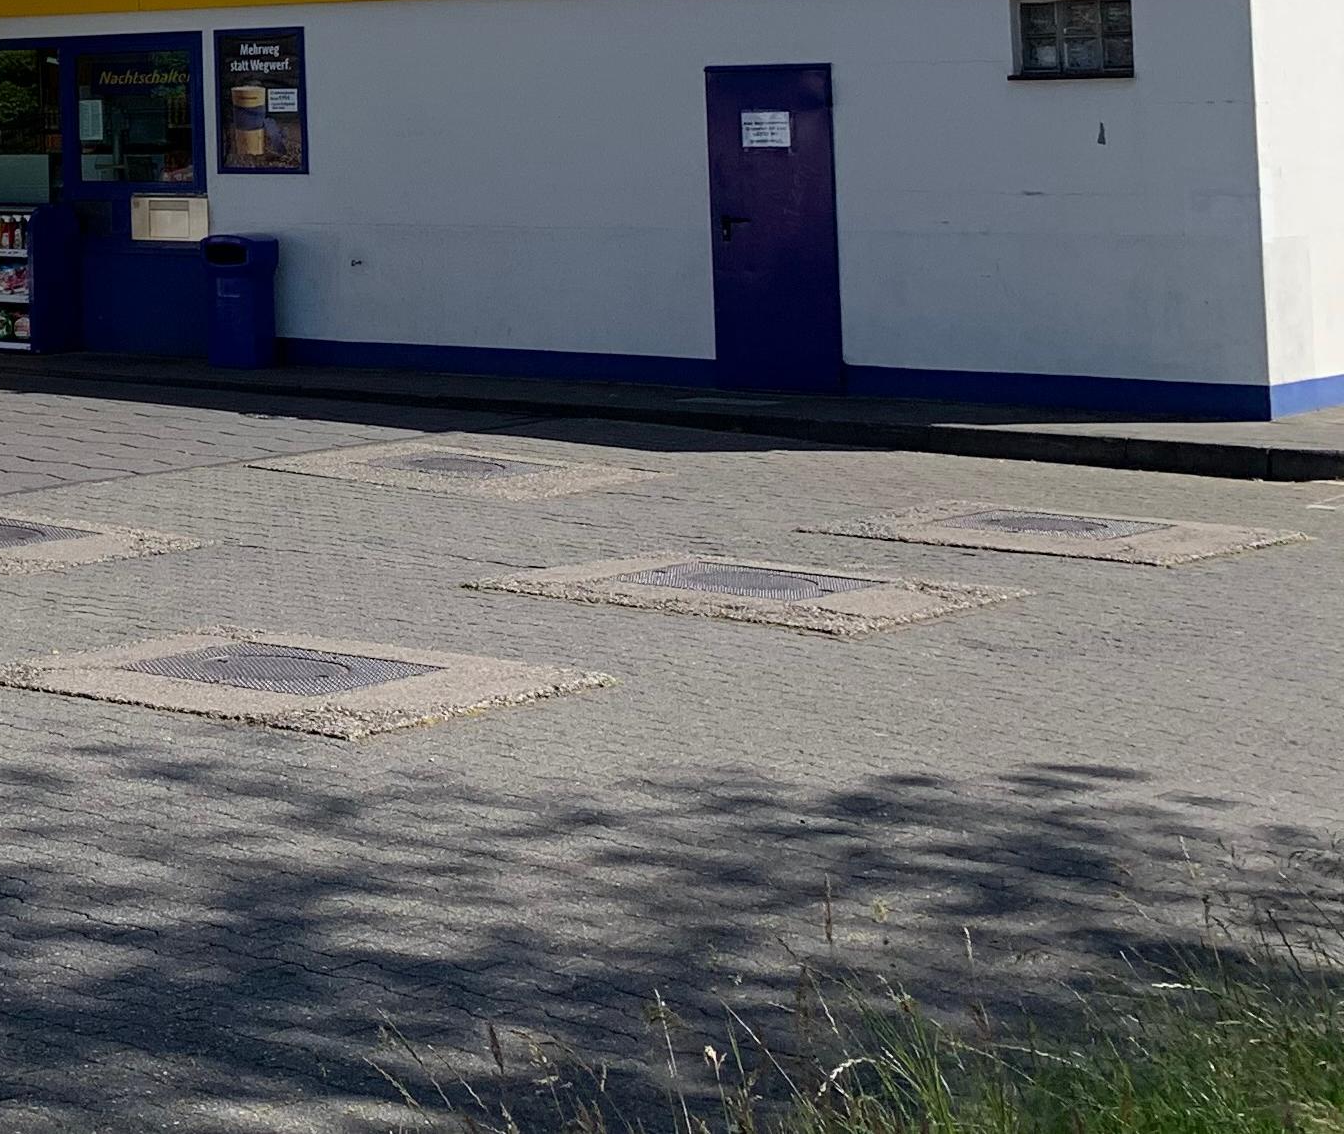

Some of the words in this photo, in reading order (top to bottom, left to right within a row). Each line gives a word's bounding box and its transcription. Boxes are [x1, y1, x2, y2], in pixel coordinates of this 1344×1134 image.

[240, 43, 279, 57] Mehrweg
[230, 59, 249, 72] statt
[250, 58, 292, 73] Wegwerf.
